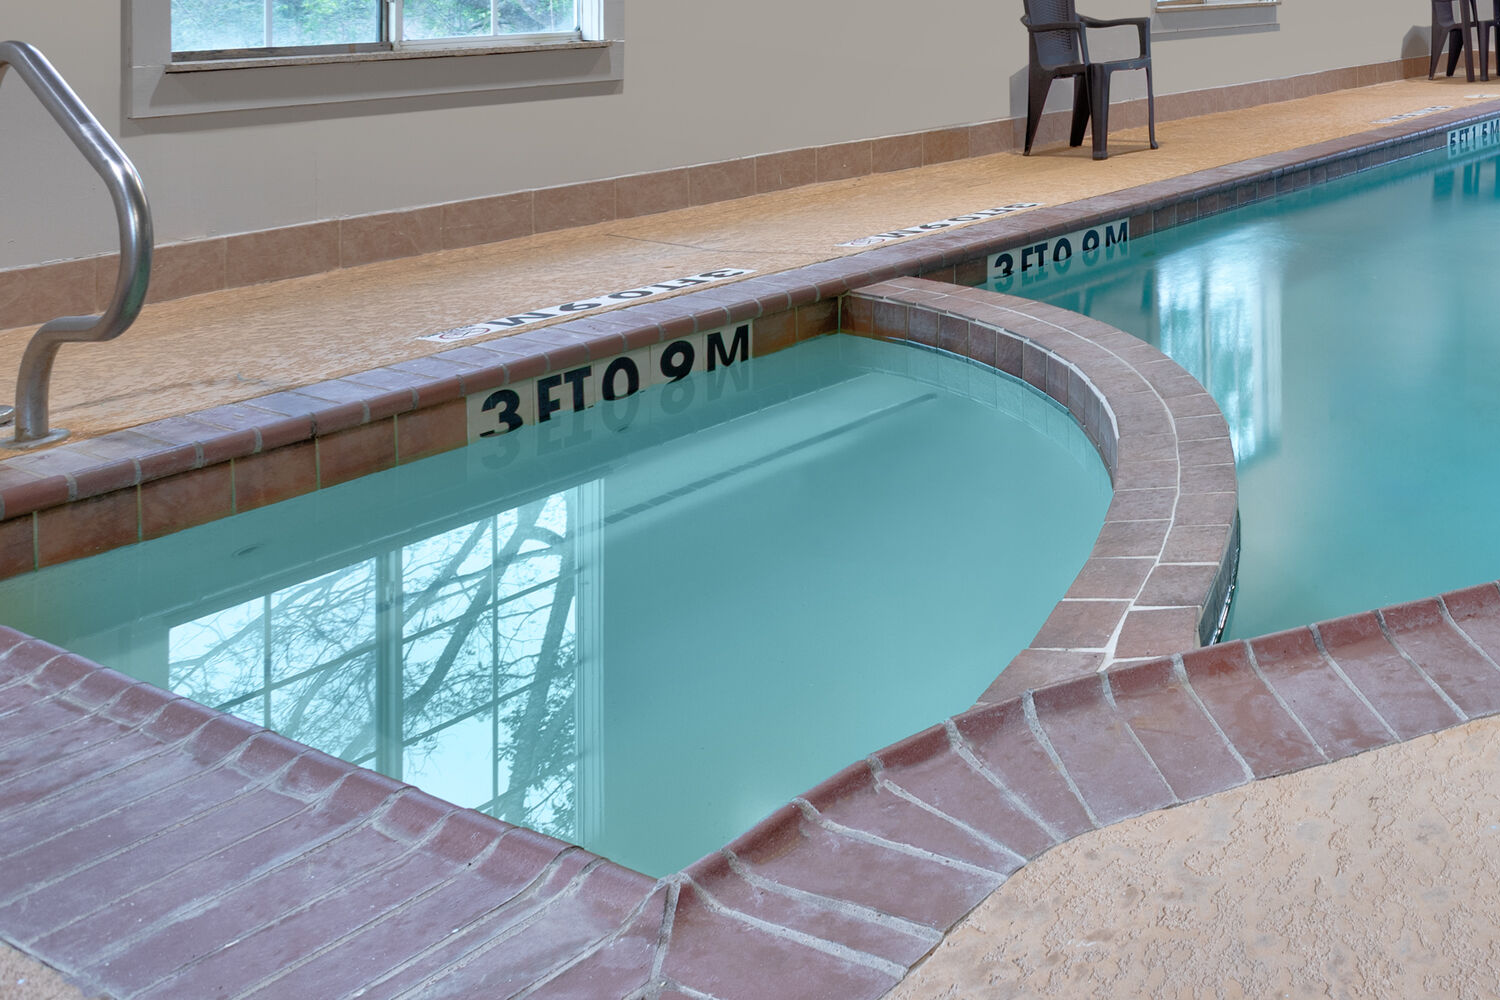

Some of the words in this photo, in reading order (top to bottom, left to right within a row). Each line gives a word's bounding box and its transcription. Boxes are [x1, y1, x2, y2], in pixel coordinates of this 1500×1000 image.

[993, 253, 1014, 279] 3
[480, 389, 523, 438] 3
[537, 365, 592, 423] FT
[707, 324, 749, 372] M
